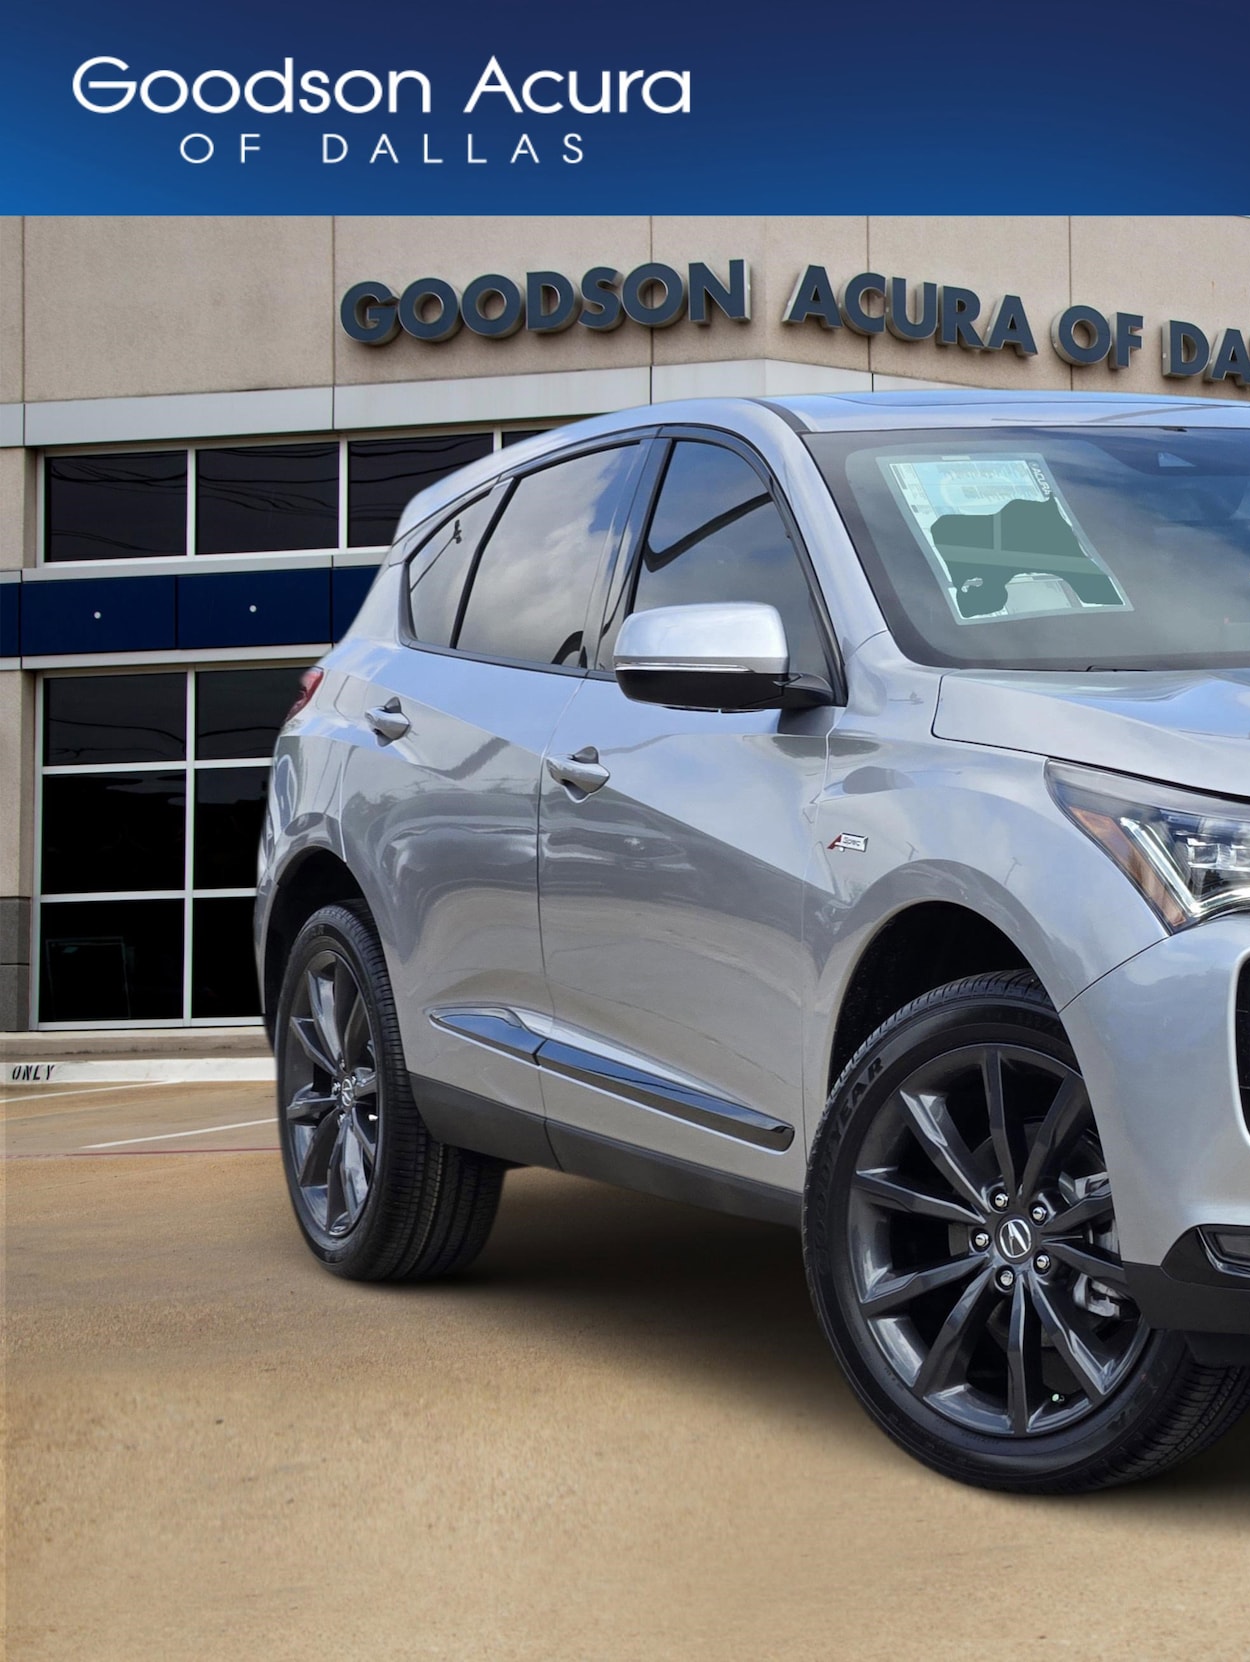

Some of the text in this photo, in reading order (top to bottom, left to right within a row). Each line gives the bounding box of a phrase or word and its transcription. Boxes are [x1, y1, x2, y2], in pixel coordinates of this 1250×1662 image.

[340, 259, 751, 346] GOODSON
[782, 264, 1038, 358] ACURA
[1051, 305, 1144, 371] OF
[12, 1064, 55, 1081] ONLY
